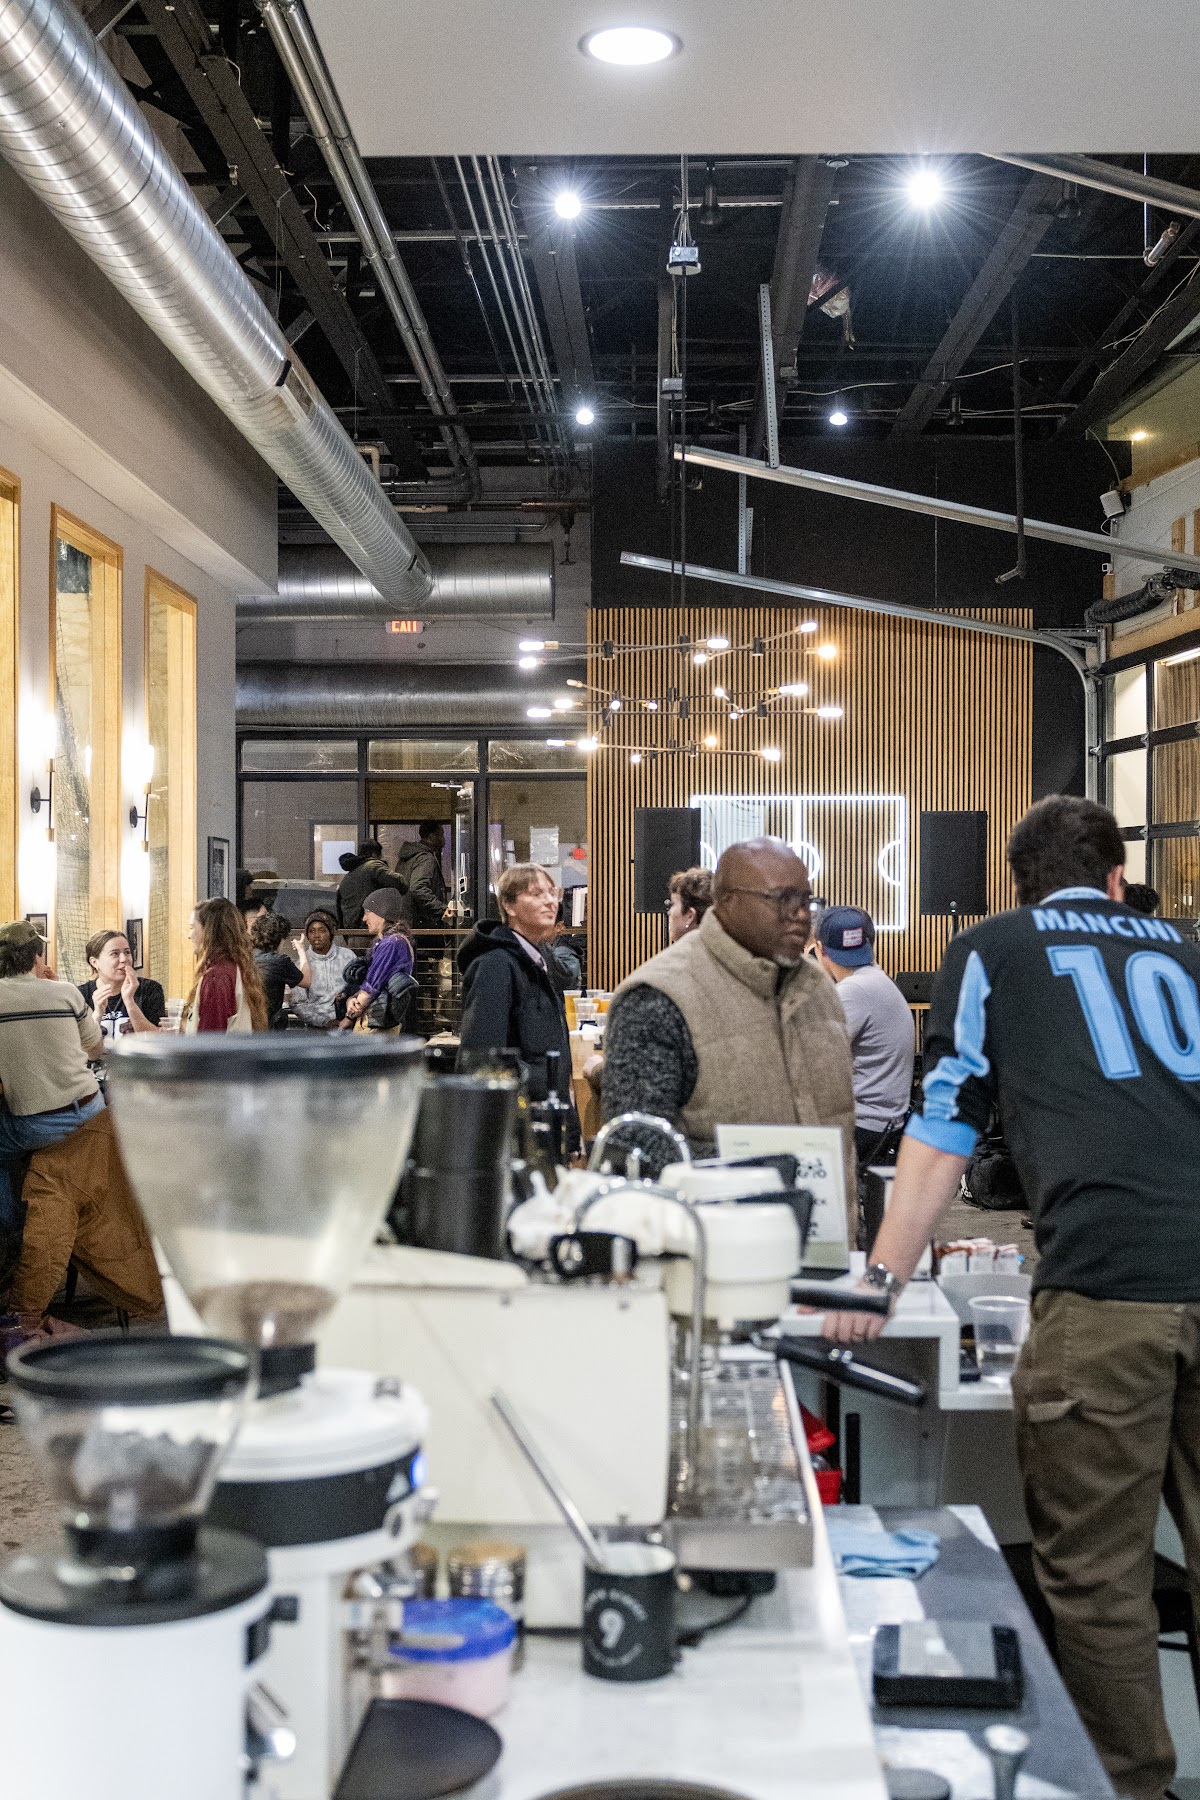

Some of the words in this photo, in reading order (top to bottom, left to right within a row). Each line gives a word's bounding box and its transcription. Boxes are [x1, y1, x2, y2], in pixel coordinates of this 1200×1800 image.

[1032, 908, 1183, 944] MANCINI
[1045, 944, 1200, 1082] 10
[599, 1607, 626, 1650] 9
